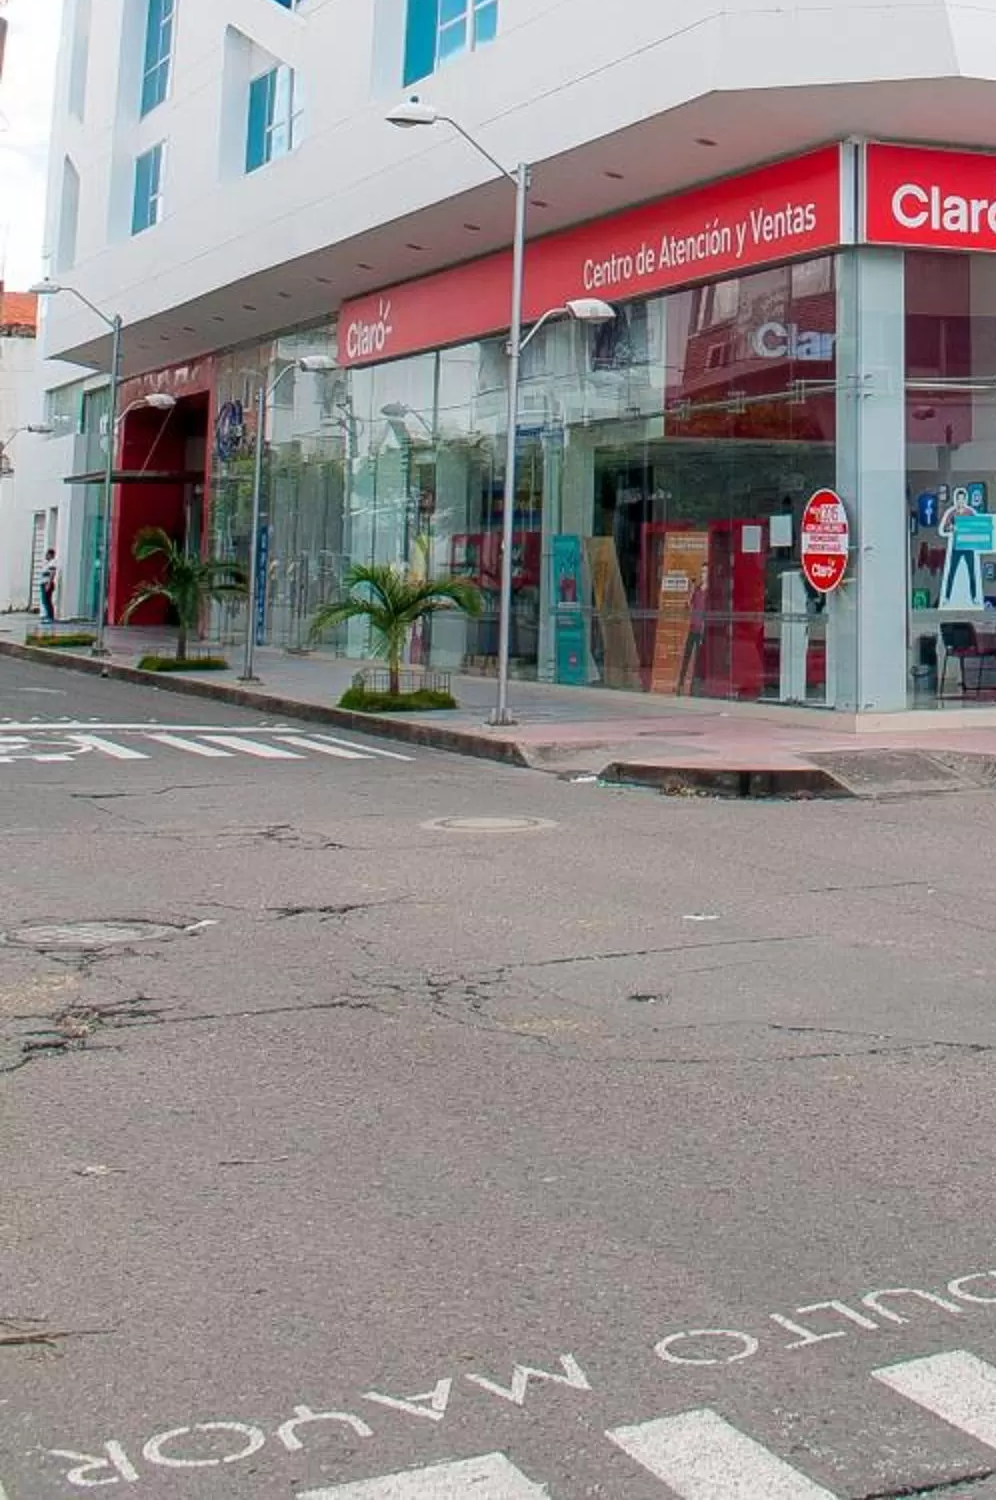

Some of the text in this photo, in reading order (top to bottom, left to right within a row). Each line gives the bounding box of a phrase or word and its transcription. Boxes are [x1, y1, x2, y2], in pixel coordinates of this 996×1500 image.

[583, 202, 817, 290] Centro de Atención y Ventas
[347, 298, 393, 359] Claro
[36, 1351, 593, 1488] MAYOR
